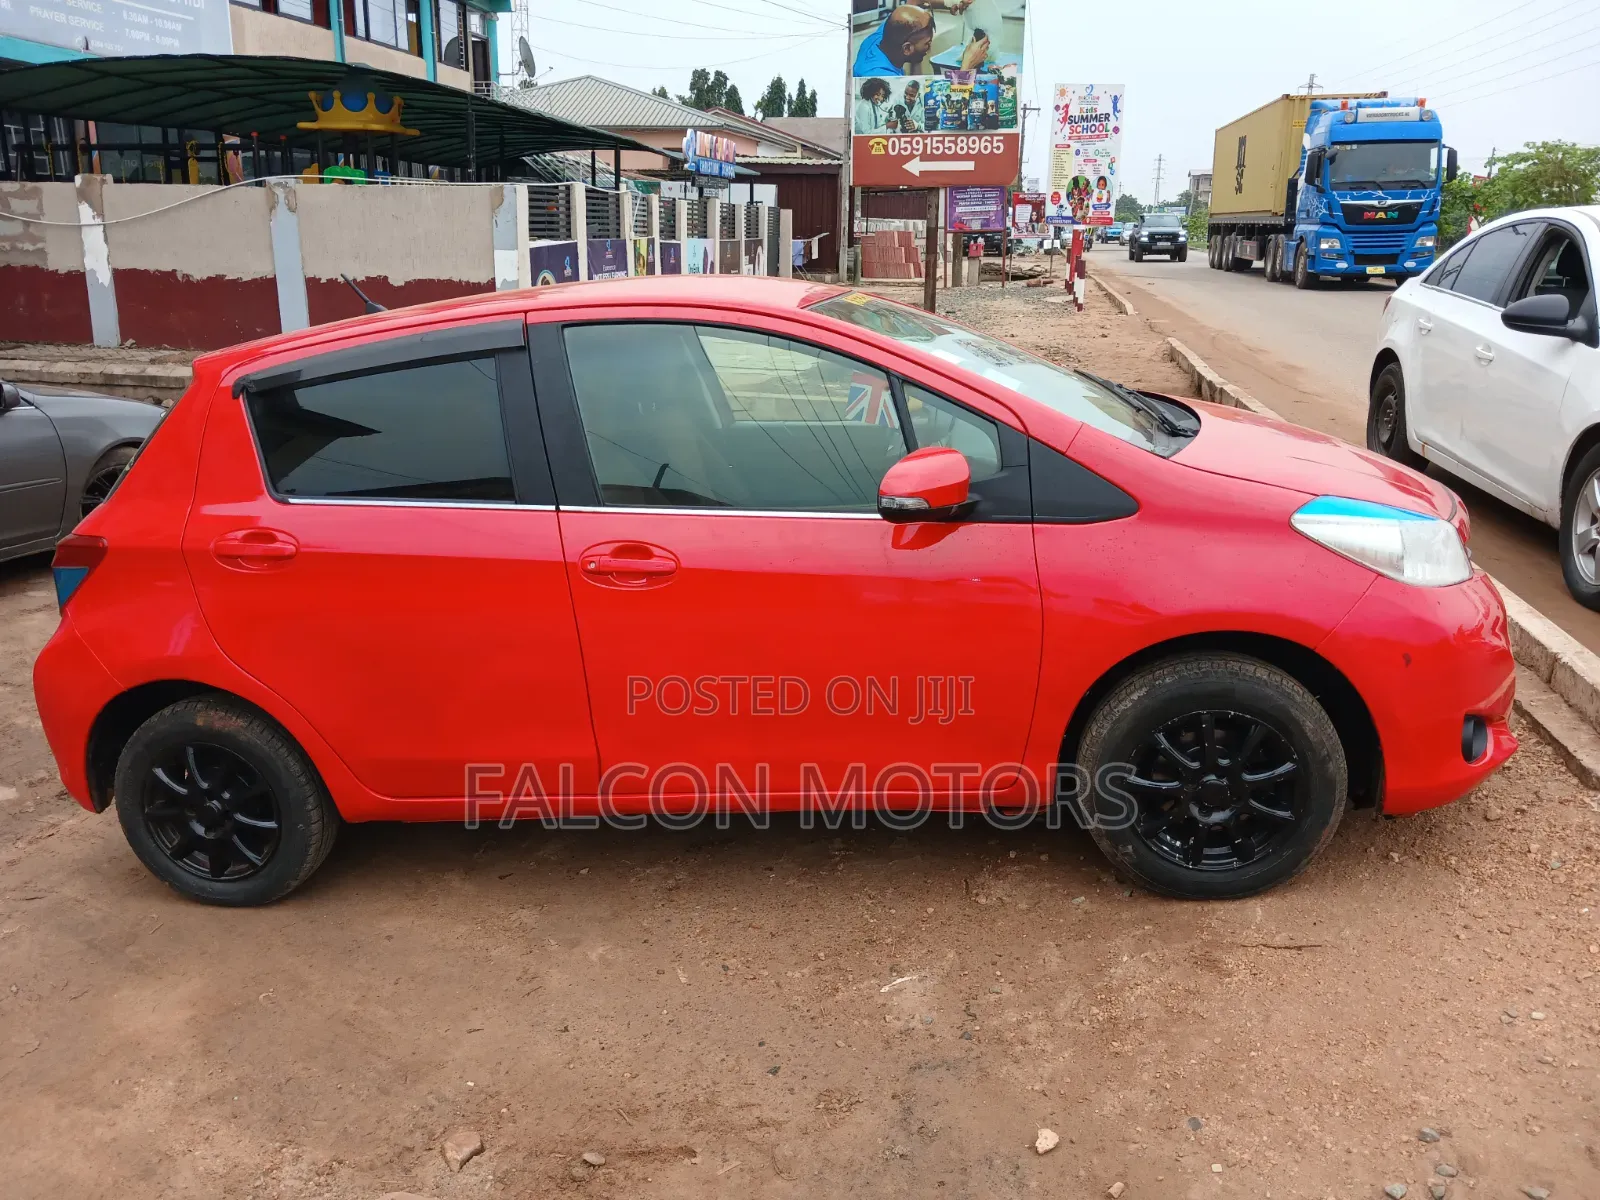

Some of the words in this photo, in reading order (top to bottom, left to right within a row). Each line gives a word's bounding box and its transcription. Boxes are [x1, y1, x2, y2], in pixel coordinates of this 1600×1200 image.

[66, 0, 104, 14] SERVICE
[29, 5, 68, 24] PRAYER
[67, 15, 105, 32] SERVICE
[1079, 106, 1098, 114] Kids
[1067, 112, 1111, 125] SUMMER
[1068, 122, 1111, 135] SCHOOL
[888, 136, 1004, 155] 0591558965
[1363, 211, 1399, 219] MAN
